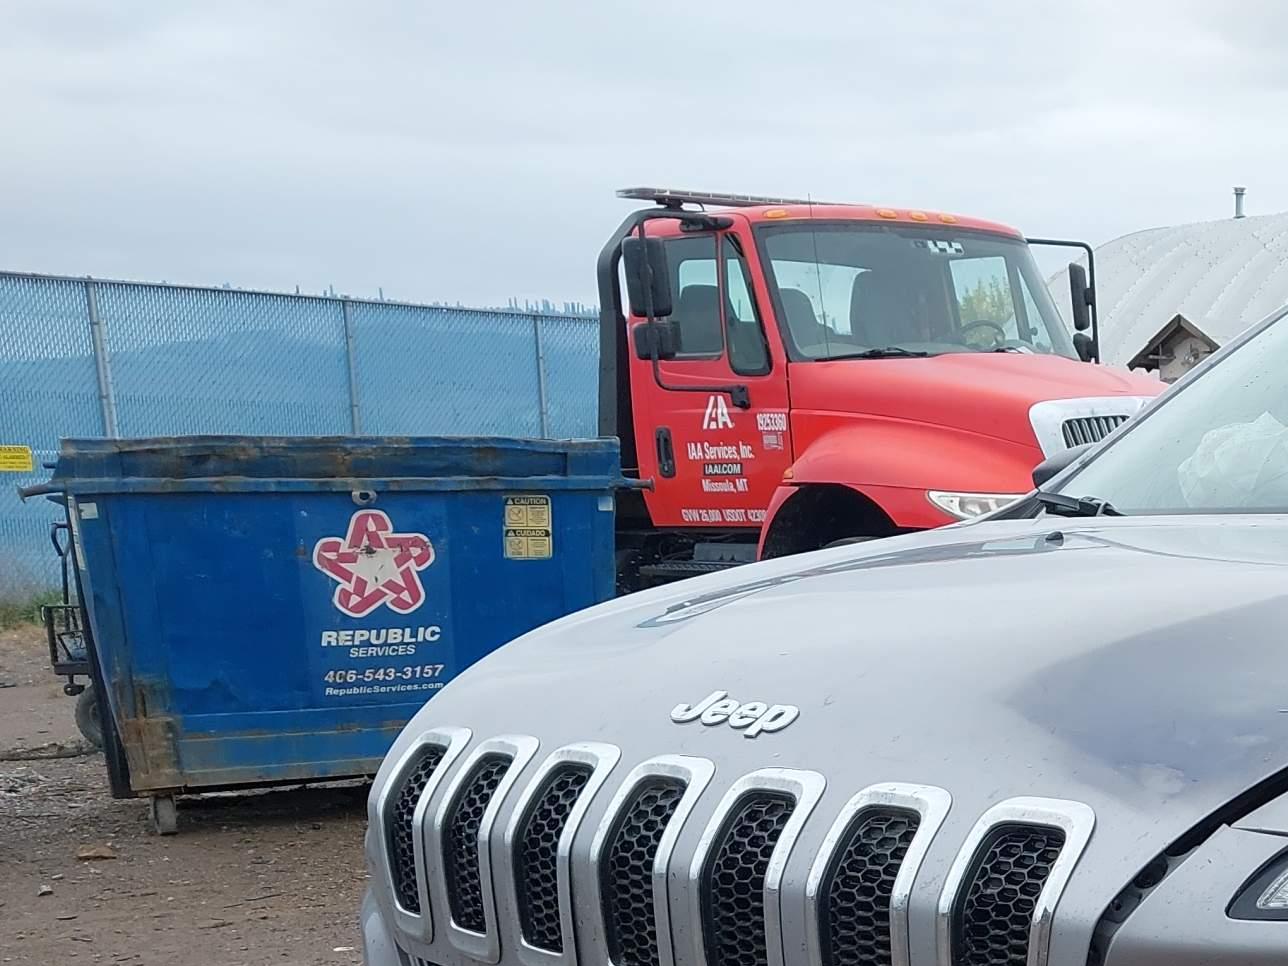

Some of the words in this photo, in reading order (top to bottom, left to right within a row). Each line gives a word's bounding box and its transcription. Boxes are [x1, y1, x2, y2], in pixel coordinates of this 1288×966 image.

[687, 442, 704, 460] IAA
[703, 441, 741, 461] Services,
[739, 441, 755, 459] Inc.
[514, 497, 547, 505] CAUTION
[321, 625, 441, 647] REPUBLIC
[349, 644, 416, 658] SERVICES
[324, 664, 445, 683] 406-543-3157
[325, 682, 444, 697] RepublicServices.com
[670, 690, 801, 739] Jeep
